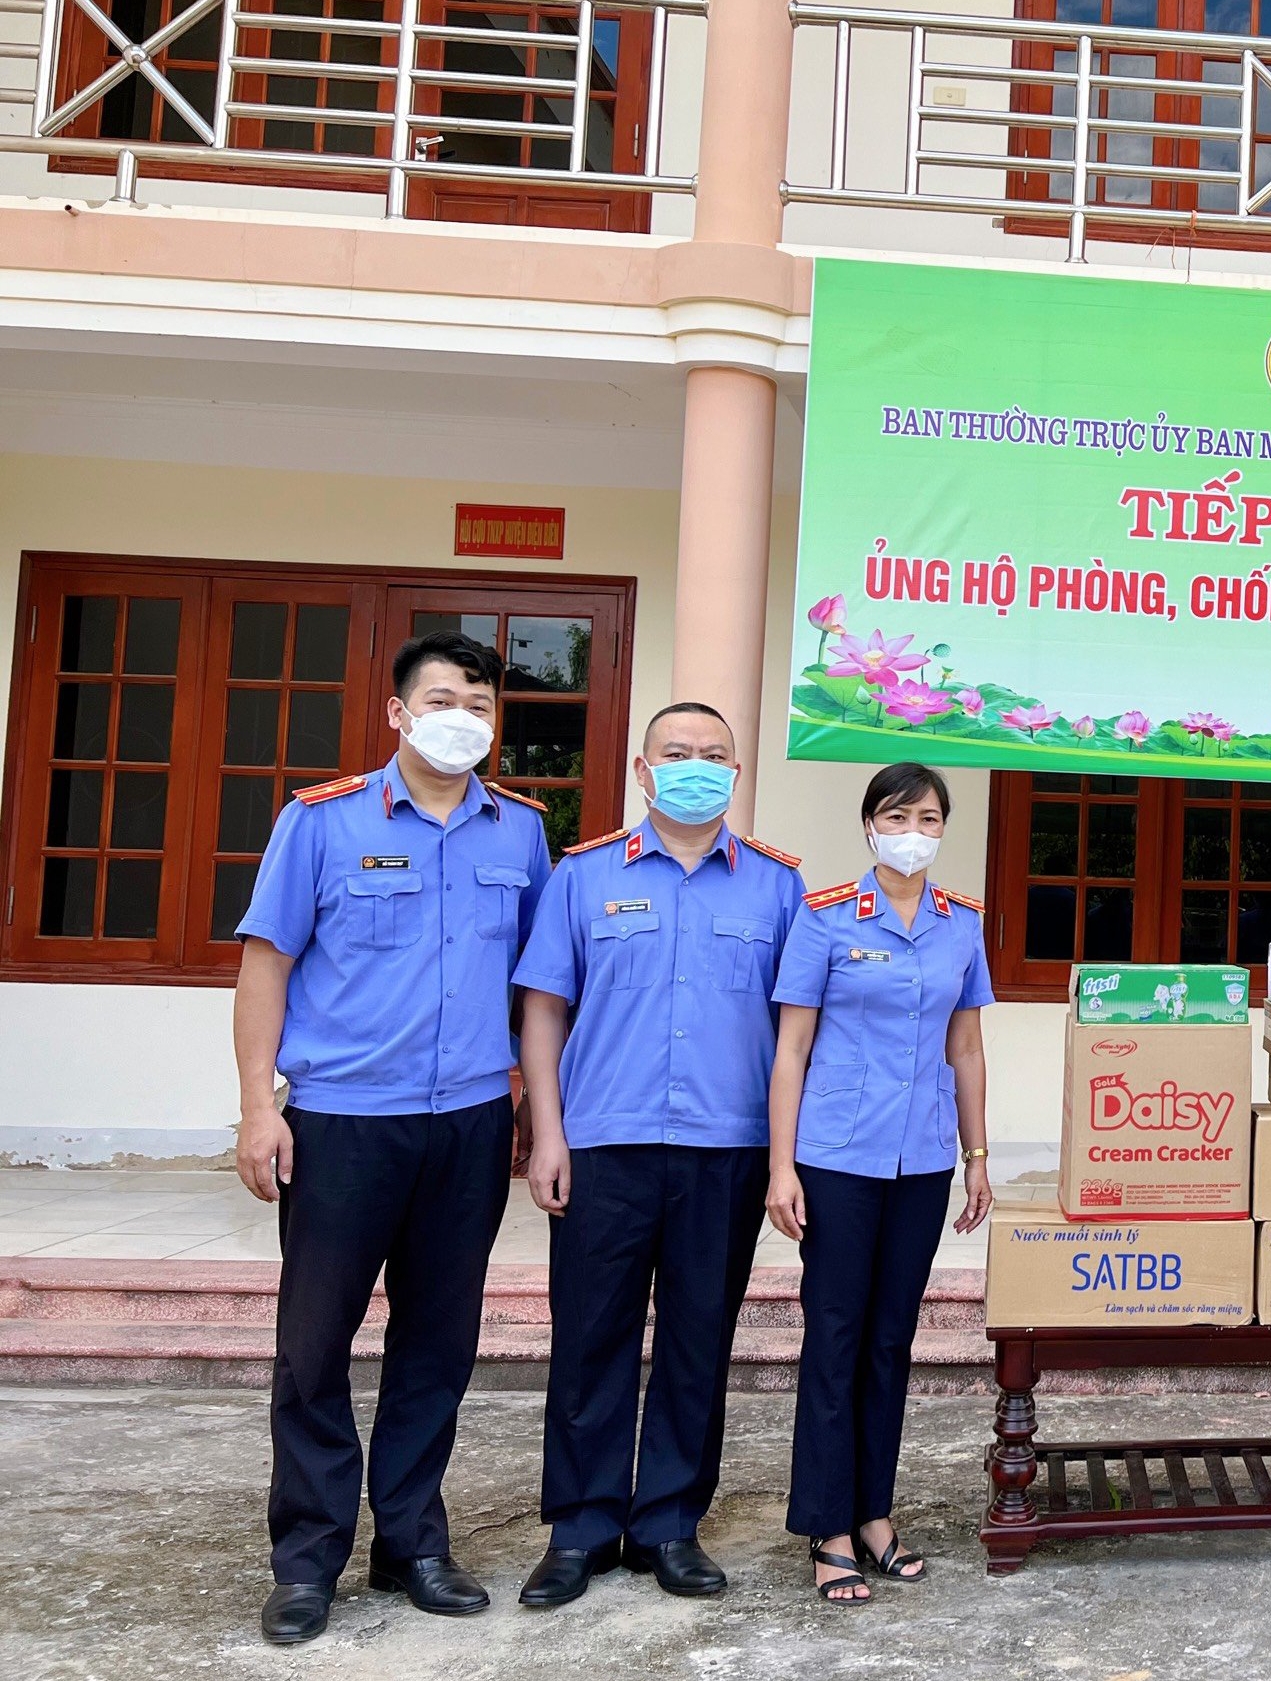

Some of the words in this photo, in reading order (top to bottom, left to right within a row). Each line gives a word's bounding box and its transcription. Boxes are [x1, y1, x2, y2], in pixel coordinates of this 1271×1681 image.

[881, 407, 943, 439] BAN
[949, 406, 1068, 446] THƯỜNG
[1073, 418, 1145, 456] TRỰC
[1150, 412, 1188, 454] ỦY
[1195, 427, 1254, 458] BAN
[865, 538, 951, 603] ỦNG
[962, 555, 1017, 617] HỘ
[1028, 558, 1177, 622] PHÒNG,
[1094, 1077, 1116, 1088] Gold
[1090, 1080, 1235, 1143] Daisy
[1088, 1144, 1153, 1163] Cream
[1158, 1143, 1234, 1162] Cracker
[1080, 1178, 1123, 1198] 236g
[1010, 1228, 1050, 1242] Nước
[1054, 1225, 1089, 1242] muối
[1093, 1229, 1122, 1242] sinh
[1127, 1228, 1139, 1245] lý
[1072, 1254, 1181, 1290] SATBB
[1105, 1304, 1124, 1313] Làm
[1126, 1304, 1144, 1314] sạch
[1147, 1305, 1156, 1313] và
[1158, 1304, 1180, 1313] chăm
[1182, 1304, 1194, 1313] sóc
[1196, 1305, 1216, 1315] răng
[1218, 1304, 1243, 1316] miệng
